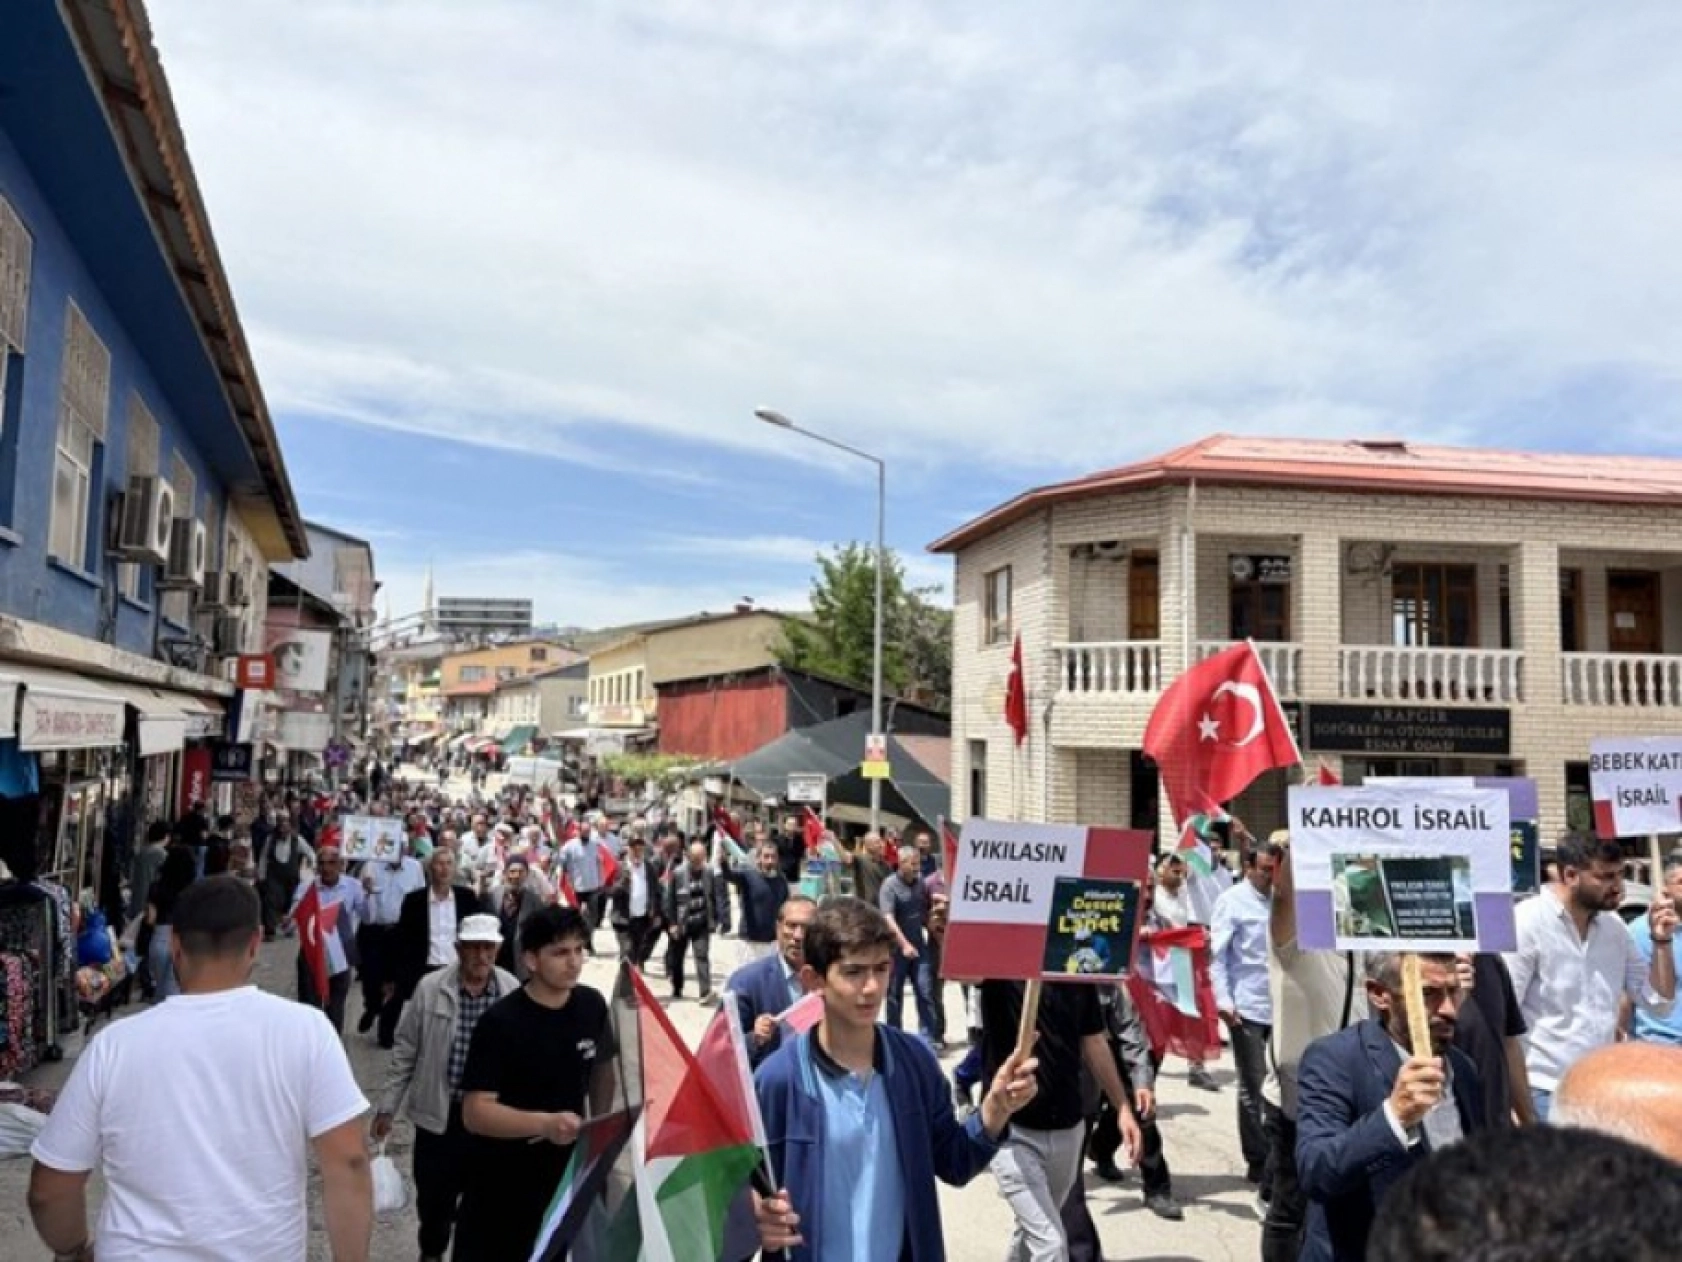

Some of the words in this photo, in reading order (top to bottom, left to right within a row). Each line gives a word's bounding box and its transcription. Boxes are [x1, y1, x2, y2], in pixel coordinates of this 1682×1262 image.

[1590, 752, 1645, 772] BEBEK
[1617, 783, 1669, 808] İSRAİL
[1302, 806, 1402, 830] KAHROL
[1415, 803, 1491, 830] İSRAİL
[970, 839, 1067, 862] YIKILASIN
[964, 875, 1032, 903] İSRAİL
[1058, 916, 1120, 933] Lanet
